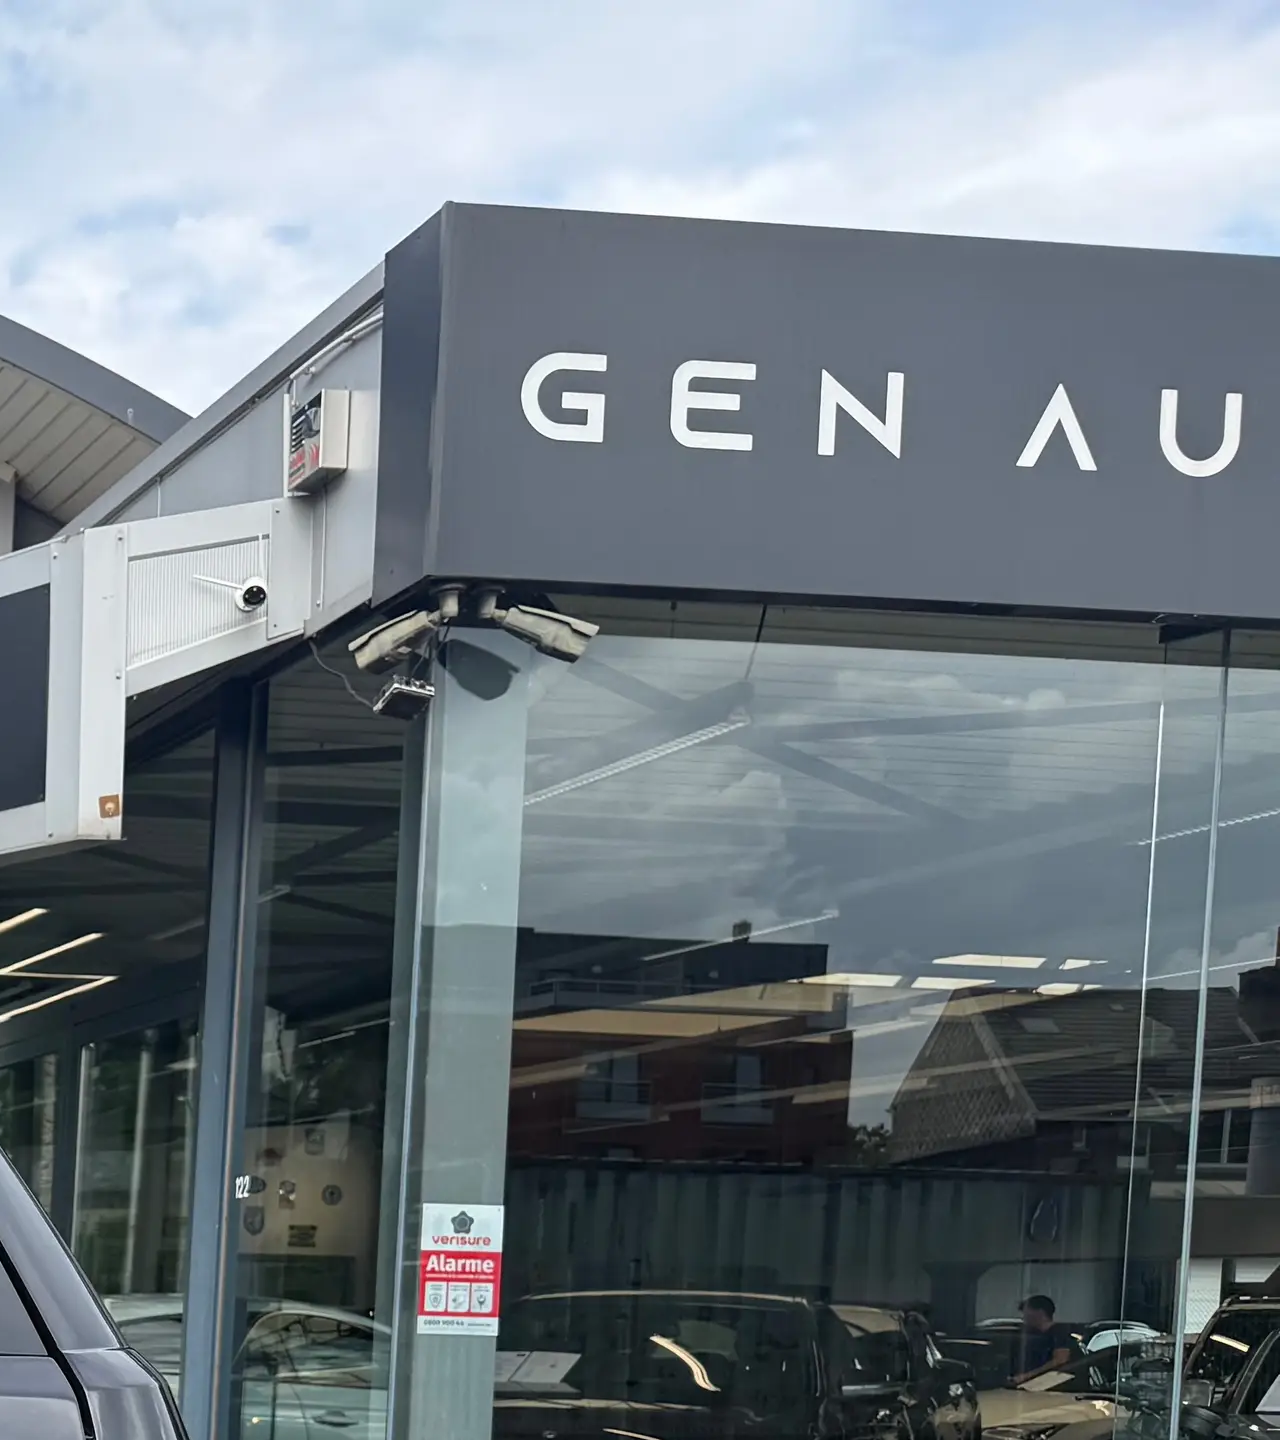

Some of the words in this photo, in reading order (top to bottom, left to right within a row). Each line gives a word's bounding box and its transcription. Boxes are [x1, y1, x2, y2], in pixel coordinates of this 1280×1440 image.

[519, 350, 906, 460] GEN
[1015, 382, 1243, 478] AU
[235, 1174, 250, 1199] 122
[432, 1235, 492, 1247] verisure
[426, 1254, 495, 1274] Alarme
